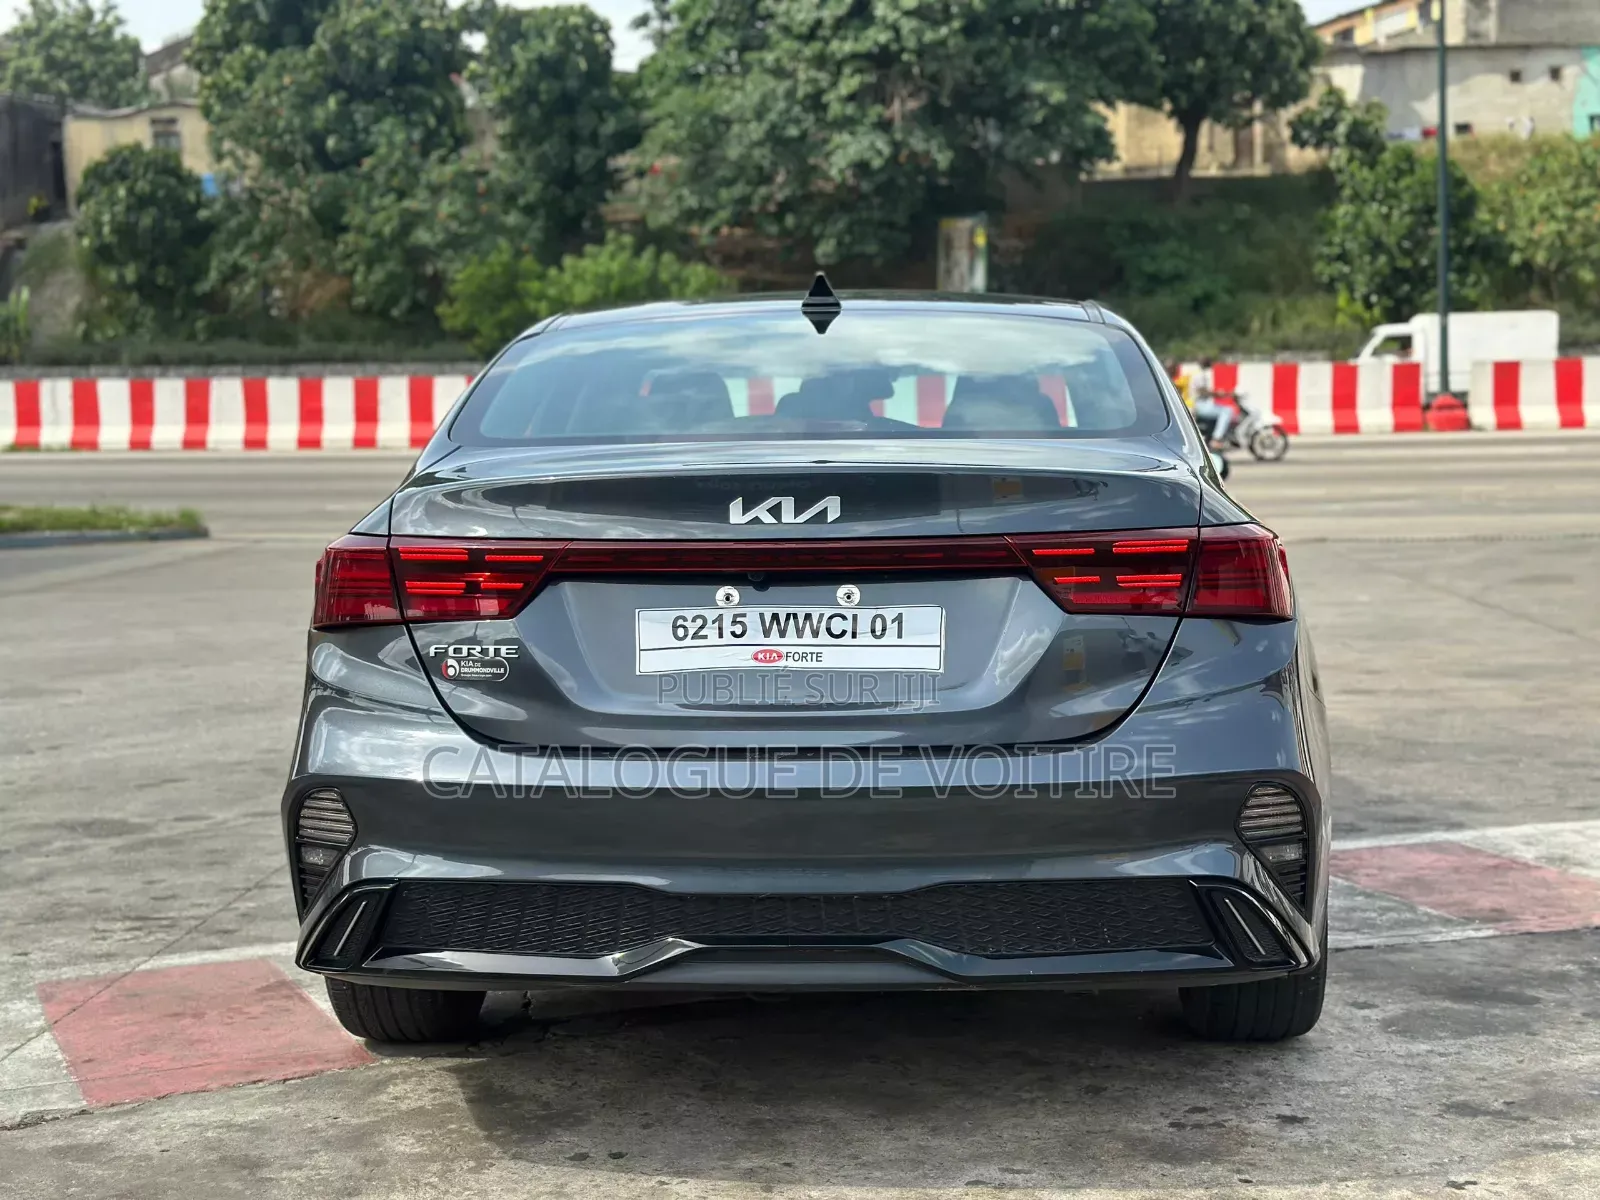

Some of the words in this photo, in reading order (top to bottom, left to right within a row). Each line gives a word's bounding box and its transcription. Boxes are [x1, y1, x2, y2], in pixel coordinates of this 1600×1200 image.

[729, 496, 841, 524] KIA
[671, 612, 748, 641] 6215
[759, 612, 858, 640] WWCI
[870, 613, 905, 640] 01
[429, 644, 519, 658] FORTE
[756, 651, 783, 661] KIA
[785, 651, 824, 663] FORTE
